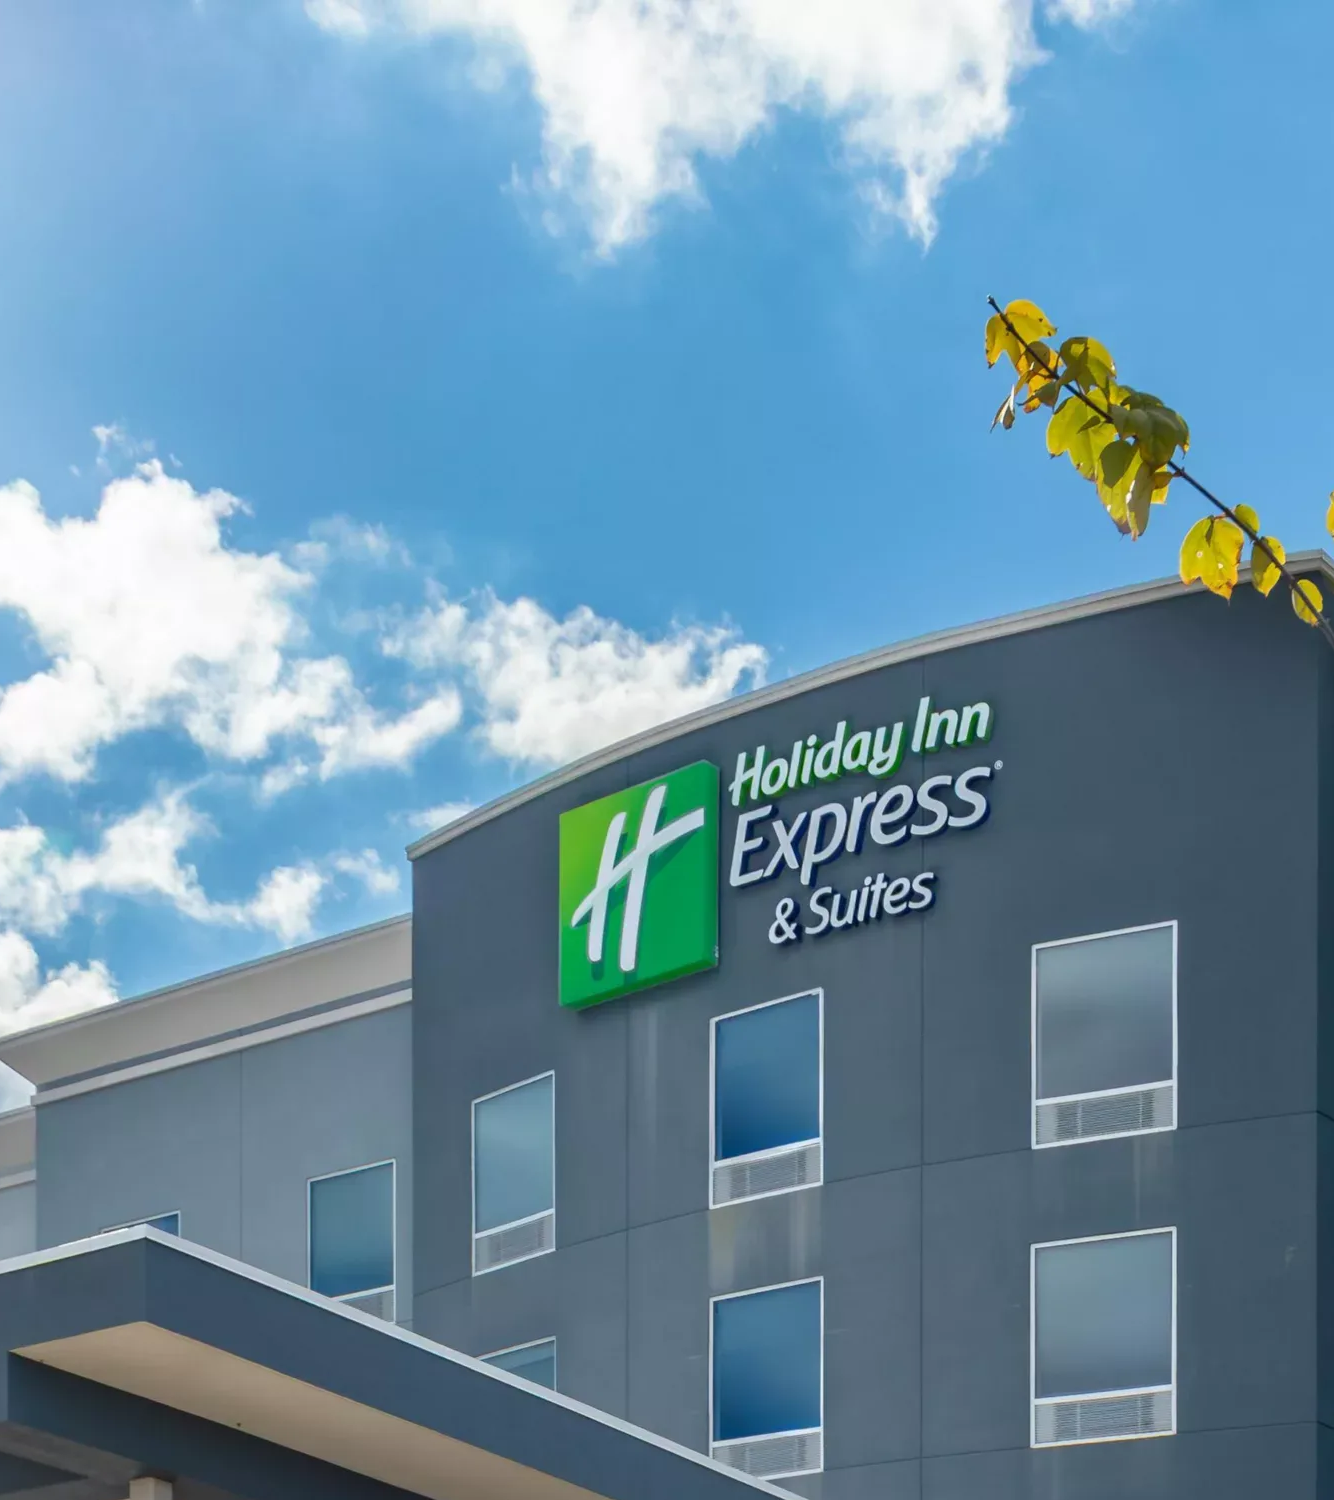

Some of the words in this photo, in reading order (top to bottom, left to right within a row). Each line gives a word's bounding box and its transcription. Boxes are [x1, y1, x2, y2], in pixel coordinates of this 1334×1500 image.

[728, 720, 904, 806] Holiday
[910, 695, 992, 753] Inn
[767, 897, 797, 945] &
[804, 871, 935, 935] Suites
